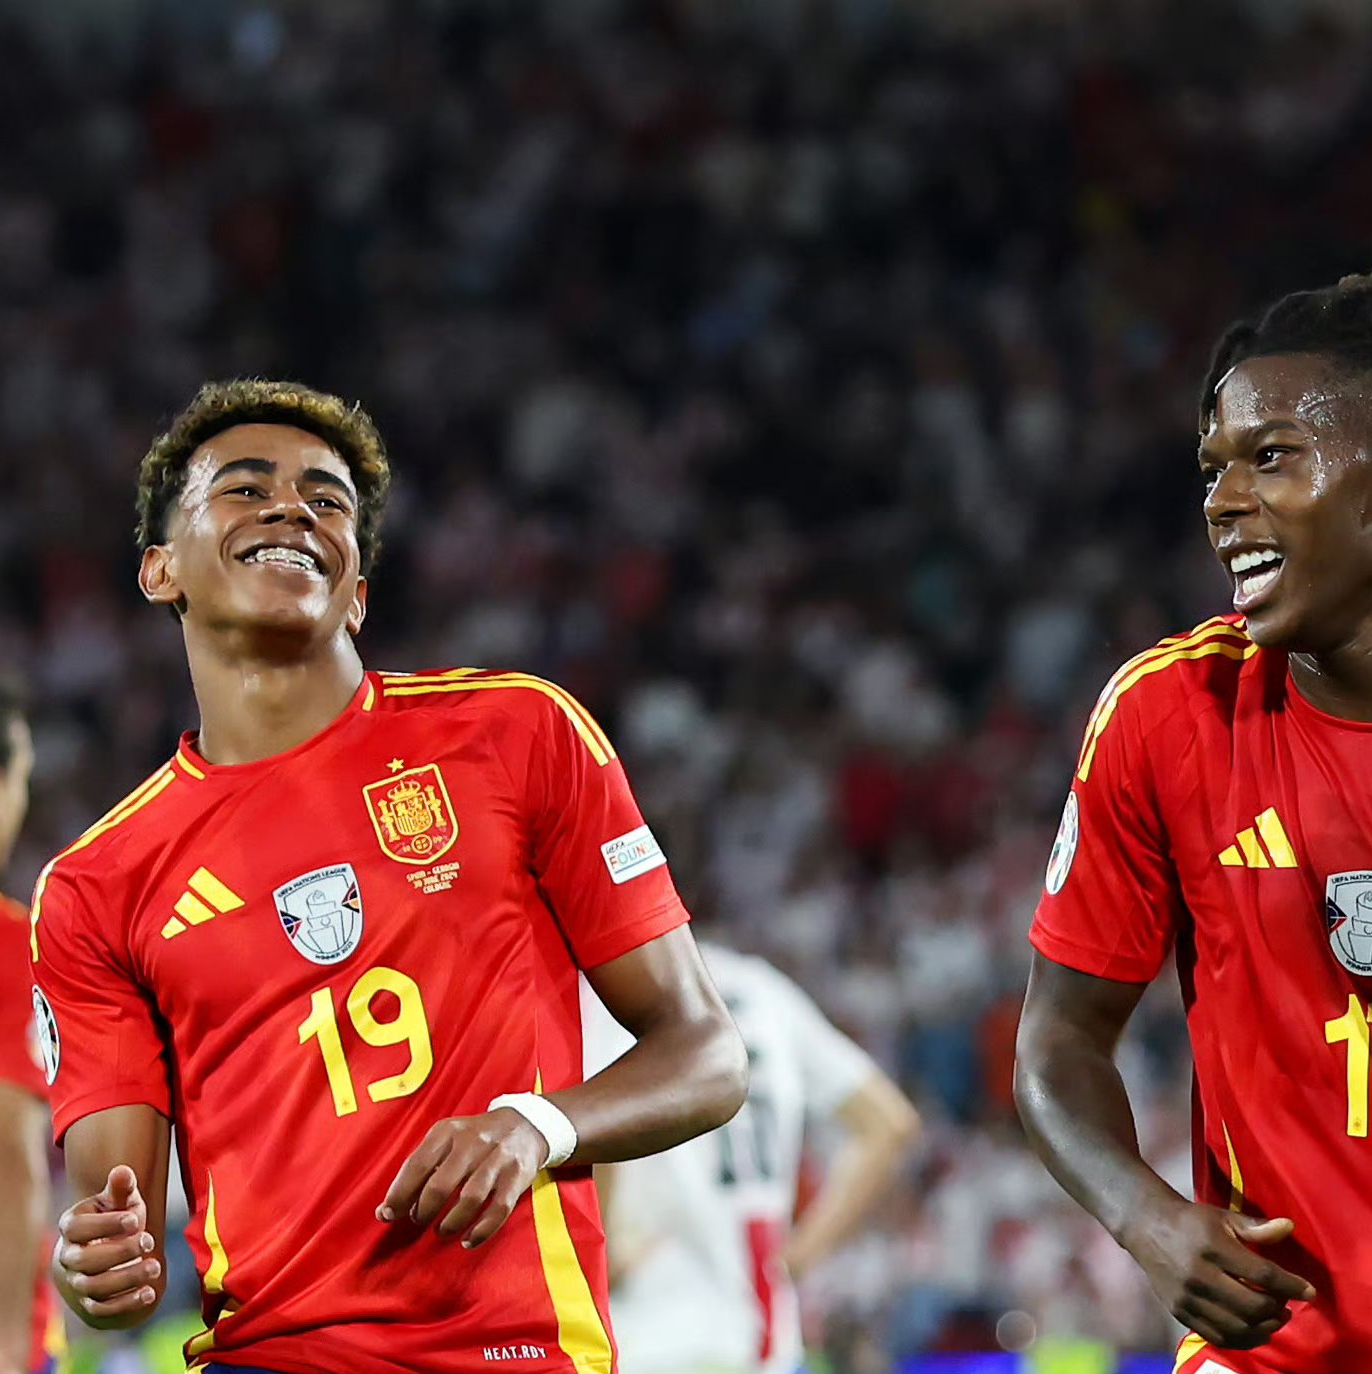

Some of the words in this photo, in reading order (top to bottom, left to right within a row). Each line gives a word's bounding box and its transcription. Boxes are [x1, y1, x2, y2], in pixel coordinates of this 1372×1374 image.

[606, 841, 626, 855] UEFA
[1331, 875, 1349, 884] UEFA
[298, 966, 434, 1118] 19
[483, 1344, 547, 1361] HEAT.RDY
